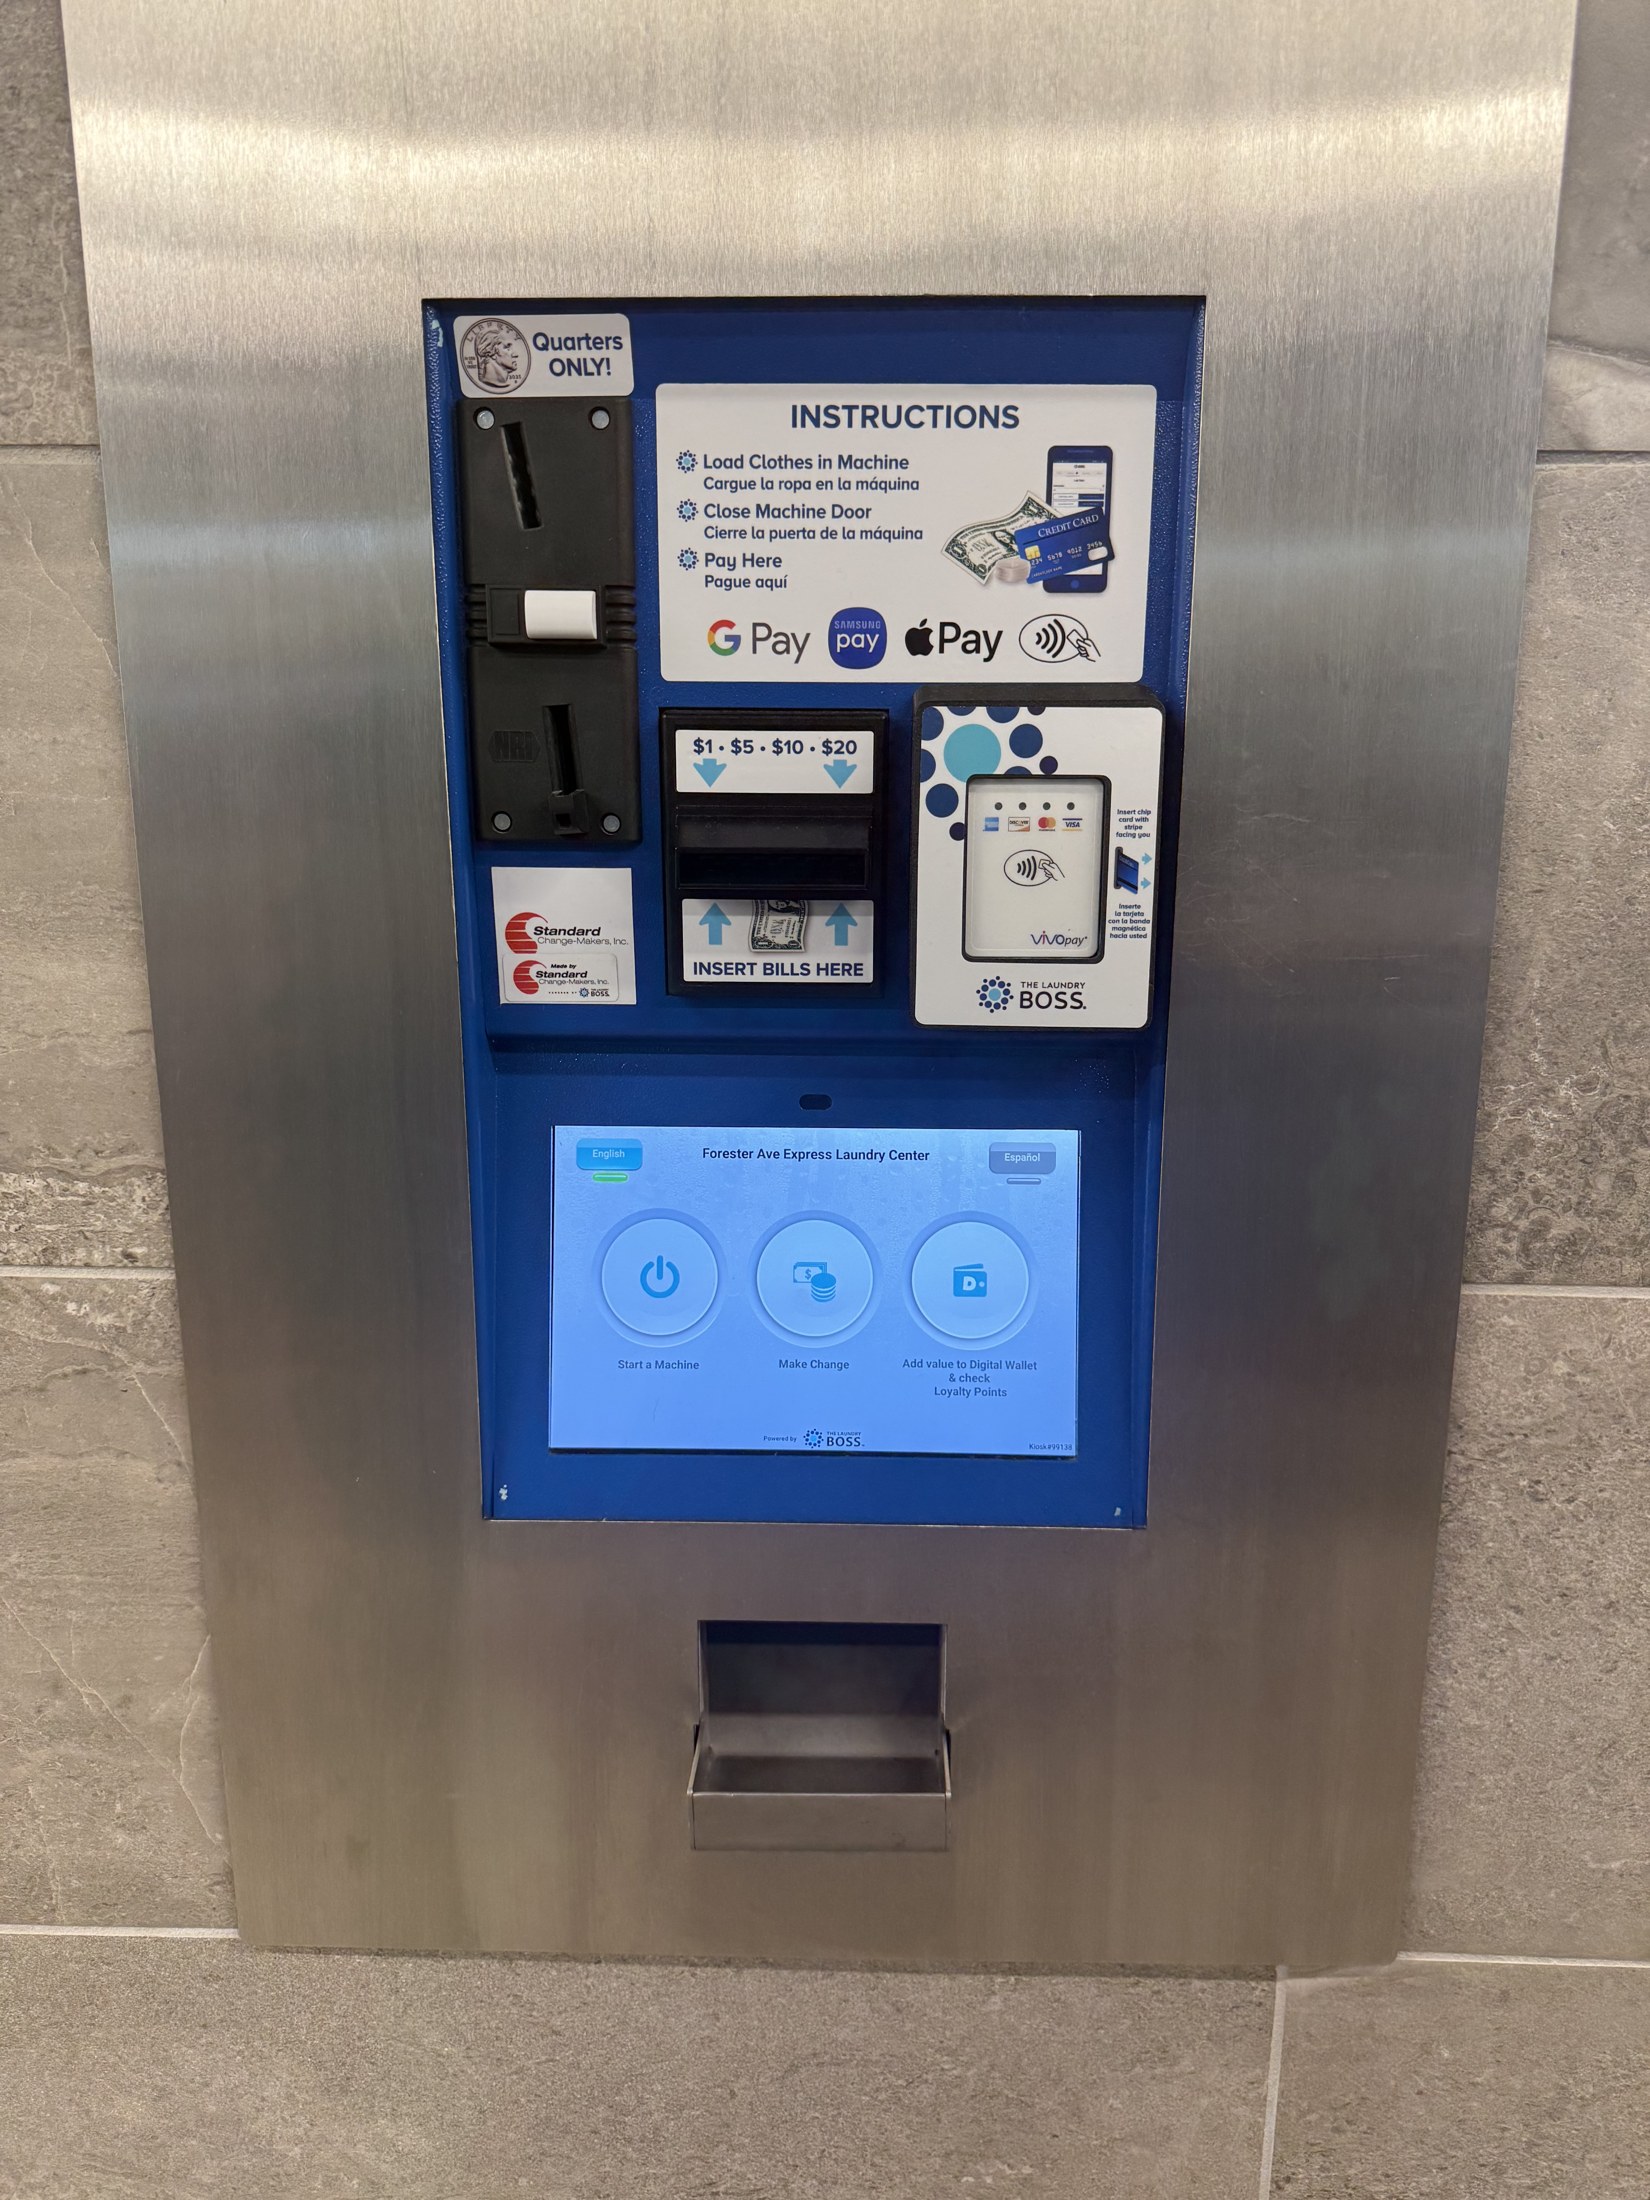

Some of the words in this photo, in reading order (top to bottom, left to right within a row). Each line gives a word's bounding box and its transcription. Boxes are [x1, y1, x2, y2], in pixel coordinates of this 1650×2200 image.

[532, 332, 623, 352] Quarters
[549, 358, 611, 377] ONLY!
[791, 404, 1020, 429] INSTRUCTIONS
[703, 455, 744, 470] Load
[749, 454, 813, 470] Clothes
[818, 454, 833, 470] in
[838, 454, 909, 470] Machine
[703, 477, 756, 493] Cargue
[761, 477, 775, 490] la
[779, 479, 812, 493] ropa
[816, 480, 833, 490] en
[838, 477, 851, 490] la
[856, 477, 919, 493] máquina
[704, 504, 750, 519] Close
[755, 504, 827, 519] Machine
[832, 504, 872, 519] Door
[1038, 522, 1072, 538] CREDIT
[1072, 514, 1099, 528] CARD
[704, 527, 747, 540] Cierre
[751, 527, 765, 540] la
[768, 528, 816, 543] puerta
[820, 526, 837, 540] de
[842, 526, 856, 540] la
[860, 526, 923, 542] máquina
[704, 553, 738, 570] Pay
[742, 553, 782, 568] Here
[704, 576, 751, 591] Pague
[755, 575, 787, 591] aquí
[834, 620, 881, 630] SAMSUNG
[707, 619, 741, 656] G
[752, 622, 811, 664] Pay
[836, 632, 880, 654] pay
[938, 622, 1003, 662] Pay
[693, 738, 713, 755] $1
[730, 739, 754, 755] $5
[772, 738, 804, 755] $10
[821, 738, 857, 756] $20
[1138, 809, 1151, 817] chip
[1124, 824, 1143, 832] stripe
[533, 926, 601, 936] Standard
[537, 937, 612, 946] Change-Makers,
[614, 938, 629, 946] Inc.
[536, 971, 587, 979] Standard
[693, 962, 757, 976] INSERT
[763, 963, 810, 976] BILLS
[816, 963, 863, 976] HERE
[539, 978, 596, 986] Change-Makers,
[1042, 982, 1085, 990] LAUNDRY
[1020, 991, 1086, 1009] BOSS.
[592, 1149, 625, 1160] English
[703, 1148, 753, 1159] Forester
[757, 1149, 780, 1159] Ave
[783, 1149, 832, 1162] Express
[836, 1149, 885, 1163] Laundry
[889, 1150, 930, 1161] Center
[1004, 1152, 1041, 1164] Español
[618, 1360, 643, 1369] Start
[645, 1362, 652, 1370] a
[655, 1360, 699, 1370] Machine
[779, 1359, 807, 1369] Make
[810, 1359, 850, 1371] Change
[902, 1359, 923, 1369] Add
[926, 1359, 954, 1369] value
[956, 1360, 967, 1369] to
[970, 1360, 1002, 1372] Digital
[1005, 1360, 1037, 1370] Wallet
[949, 1373, 956, 1383] &
[959, 1373, 990, 1383] check
[934, 1387, 971, 1398] Loyalty
[974, 1387, 1007, 1397] Points
[763, 1435, 788, 1443] Powered
[790, 1436, 797, 1444] by
